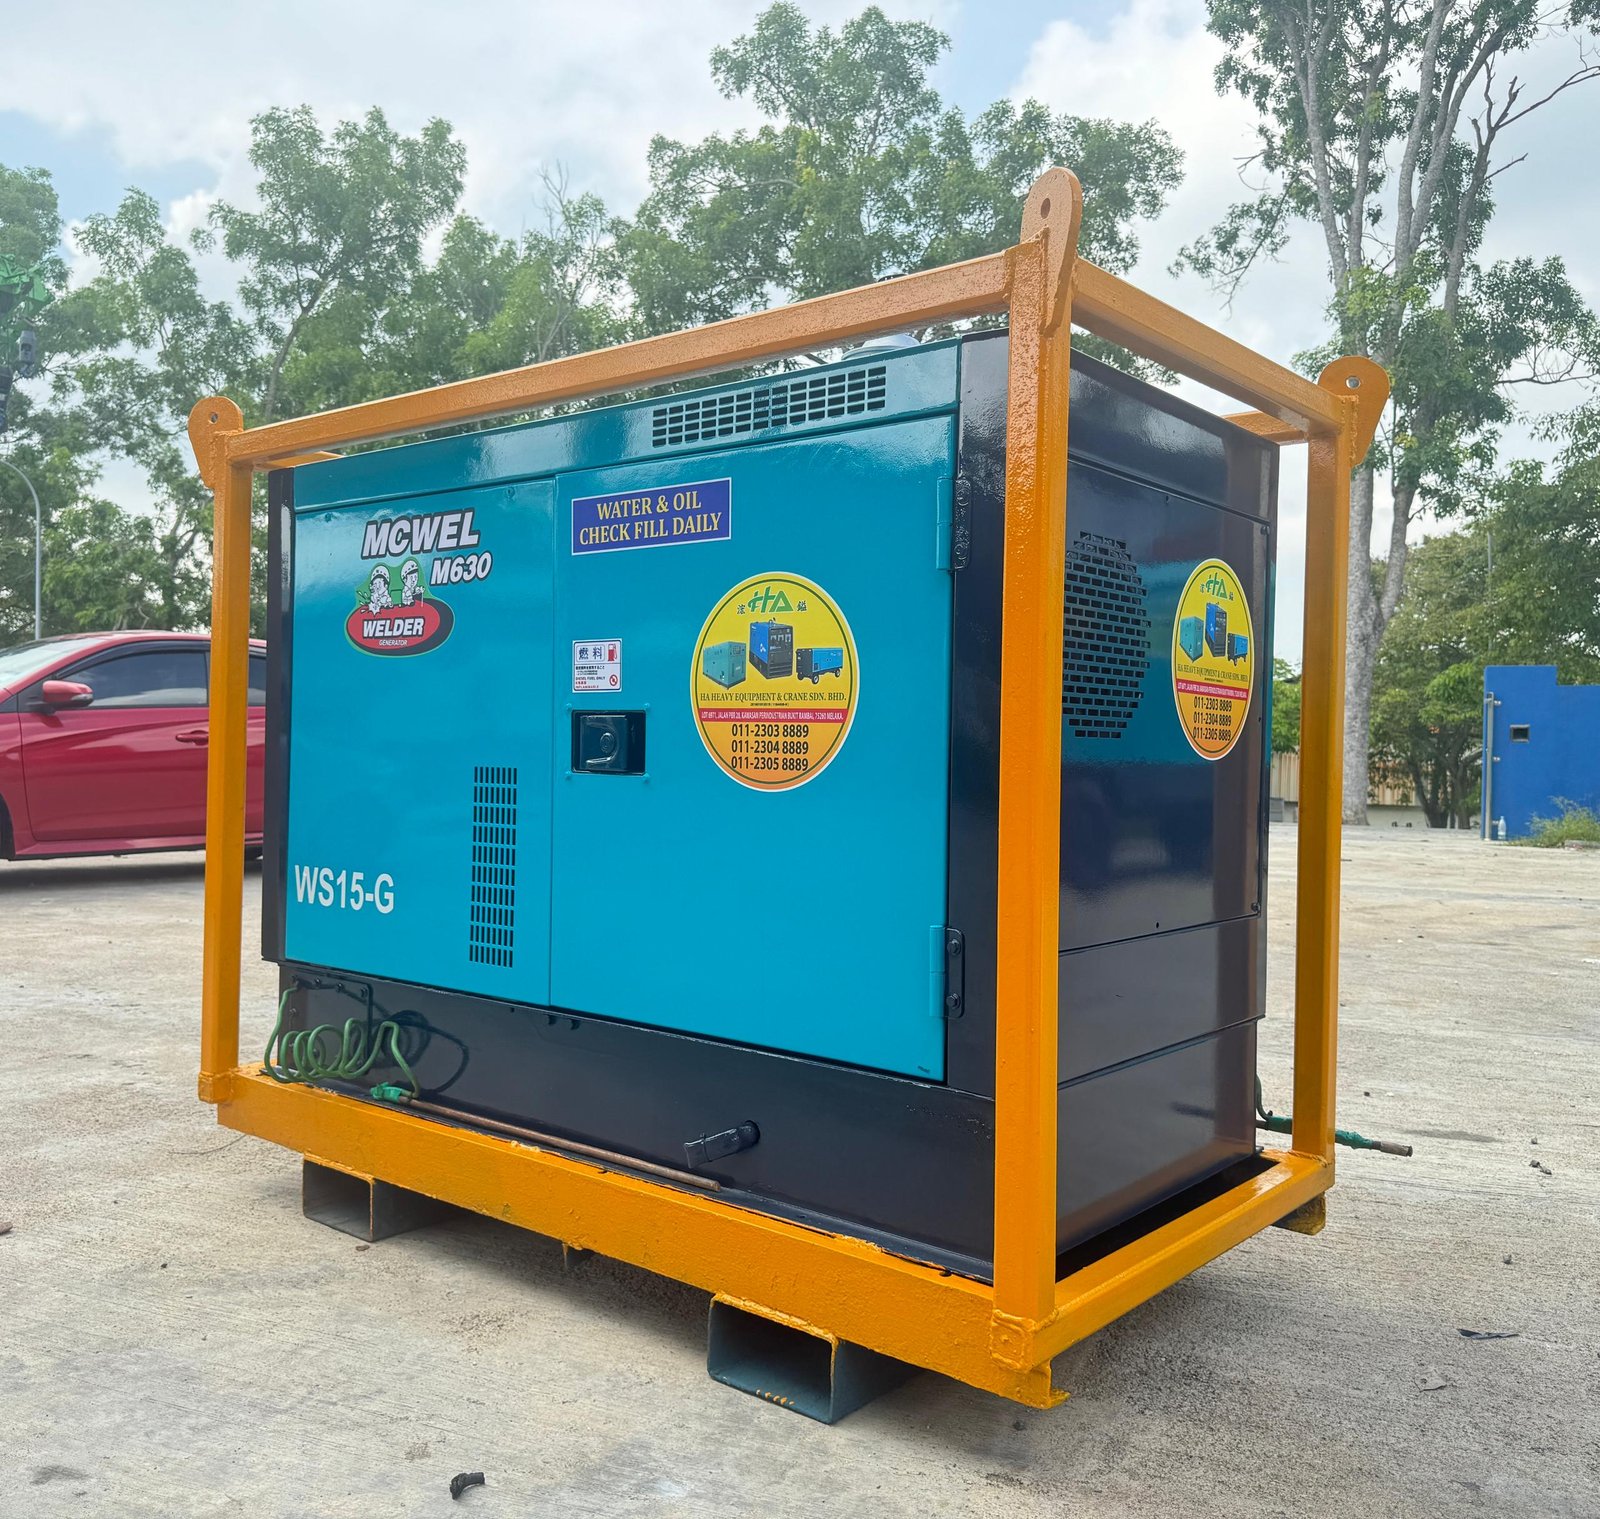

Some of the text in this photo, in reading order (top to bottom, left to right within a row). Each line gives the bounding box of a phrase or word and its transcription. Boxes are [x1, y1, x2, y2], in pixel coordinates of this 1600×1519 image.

[597, 490, 702, 520] WATER & OIL
[361, 510, 480, 557] MCWEL
[579, 512, 722, 545] CHECK FILL DAILY
[430, 551, 492, 586] M630
[362, 617, 425, 638] WELDER
[378, 639, 408, 647] GENERATOR
[700, 692, 846, 702] HA HEAVY EQUIPMENT & CRANE SDN. BHD.
[1194, 696, 1232, 712] 011-2303 8889
[1193, 711, 1231, 727] 011-2304 8889
[732, 724, 809, 738] 011-2303 8889
[1193, 727, 1231, 741] 011-2305 8889
[731, 740, 809, 754] 011-2304 8889
[731, 756, 808, 771] 011-2305 8889
[294, 864, 394, 914] WS15-G
